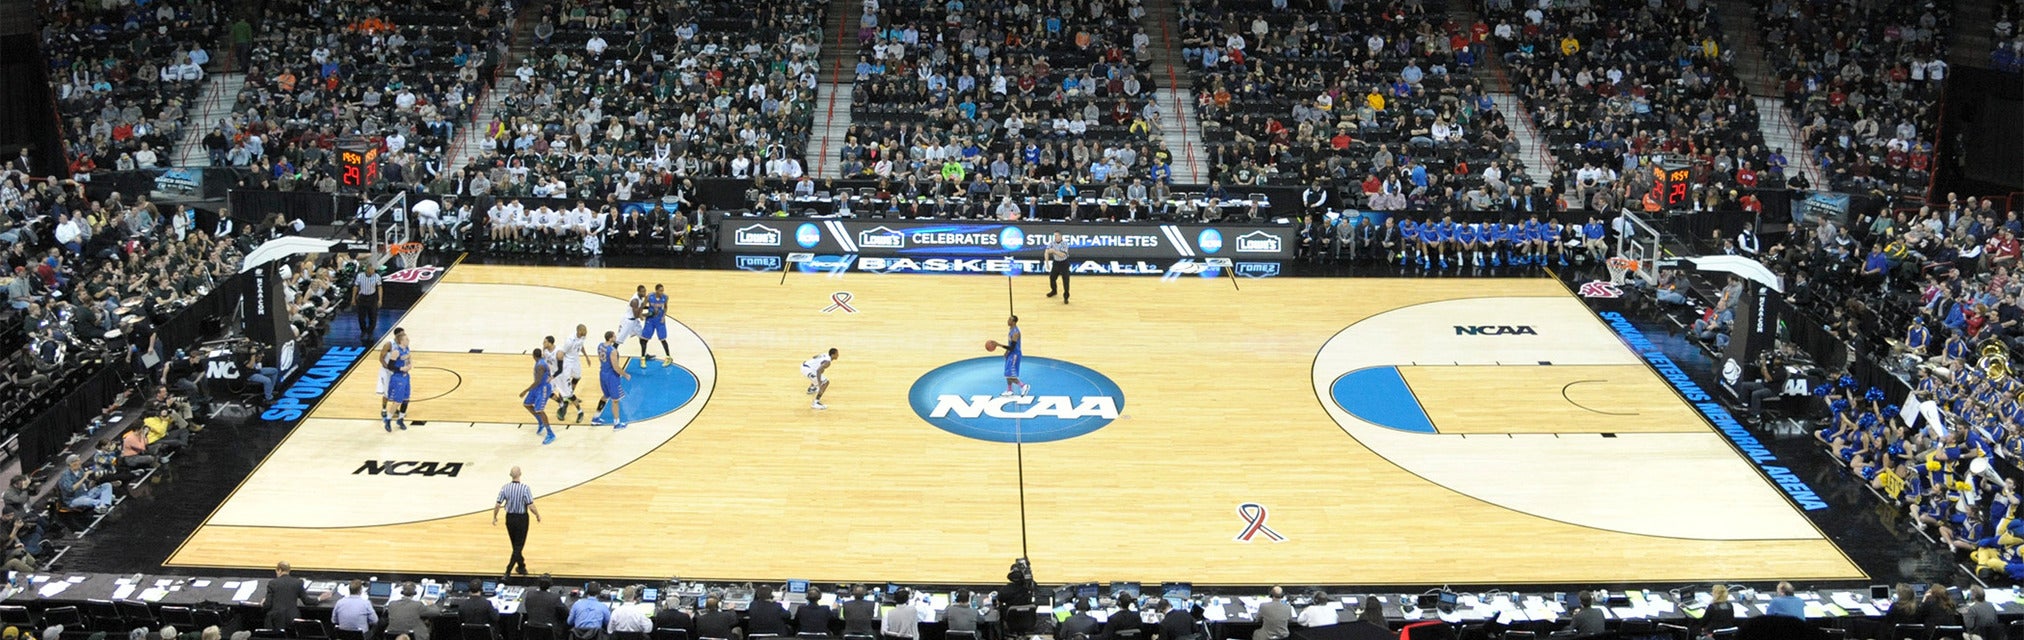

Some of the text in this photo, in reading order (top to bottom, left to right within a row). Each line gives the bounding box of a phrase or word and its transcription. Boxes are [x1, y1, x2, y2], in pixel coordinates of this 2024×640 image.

[343, 164, 360, 185] 29
[1669, 183, 1686, 204] 29
[912, 234, 997, 245] CELEBRATES
[1026, 234, 1158, 247] STUENT-ATHLETES
[857, 257, 1163, 273] BASKETALL
[1453, 325, 1538, 336] NCAA
[206, 361, 240, 379] NC
[261, 346, 366, 422] SPOKANE
[1783, 378, 1809, 396] AA
[929, 394, 1120, 419] NCAA
[1600, 311, 1657, 351] SPOKANE
[1644, 351, 1711, 401] VETERANS
[1697, 403, 1778, 464] MEMORIAL
[1762, 465, 1829, 511] ARENA
[352, 460, 464, 477] NCAA
